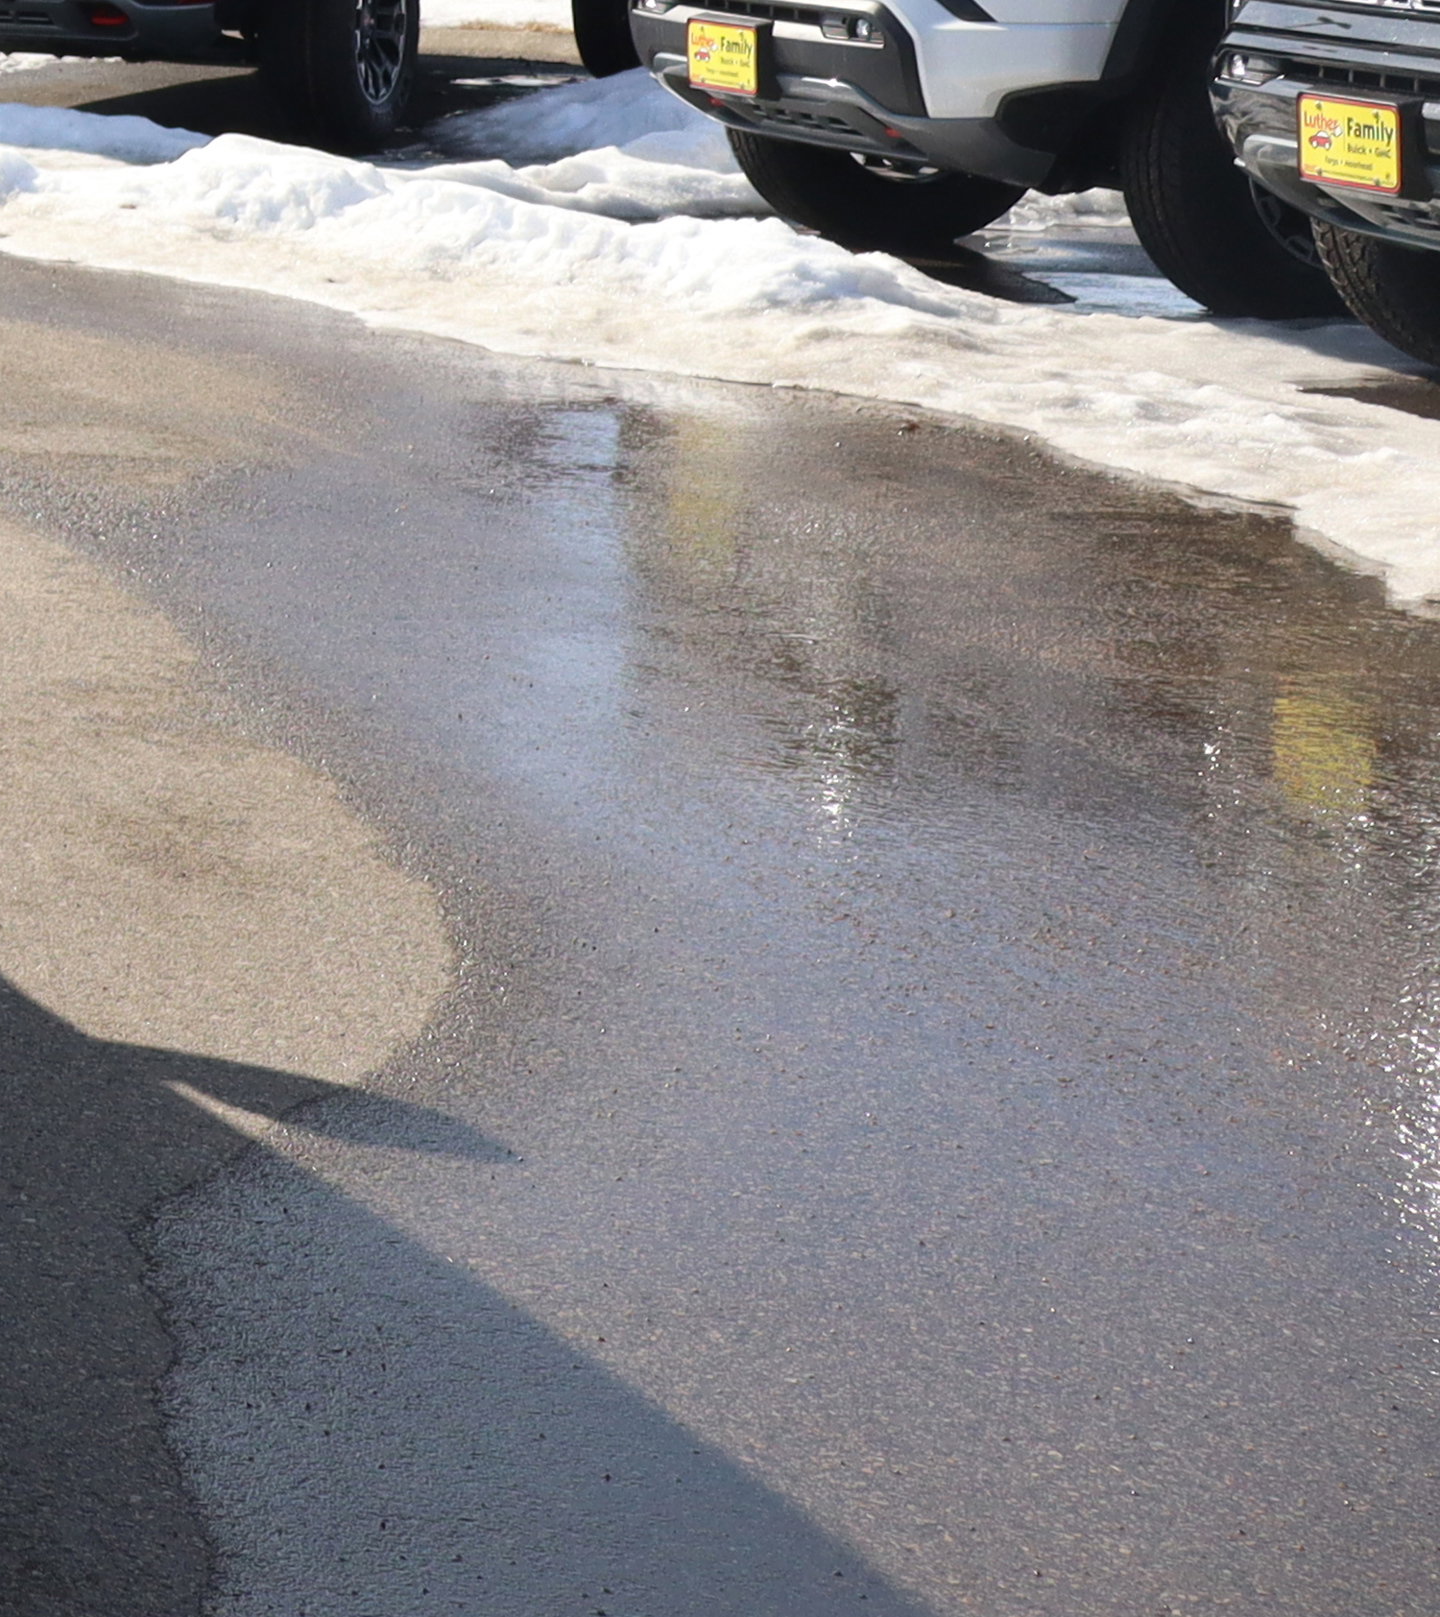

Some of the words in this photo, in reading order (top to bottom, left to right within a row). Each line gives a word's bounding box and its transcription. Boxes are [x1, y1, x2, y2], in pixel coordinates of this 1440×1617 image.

[721, 36, 752, 59] Family
[1304, 111, 1339, 131] Luther
[1347, 117, 1394, 147] Family
